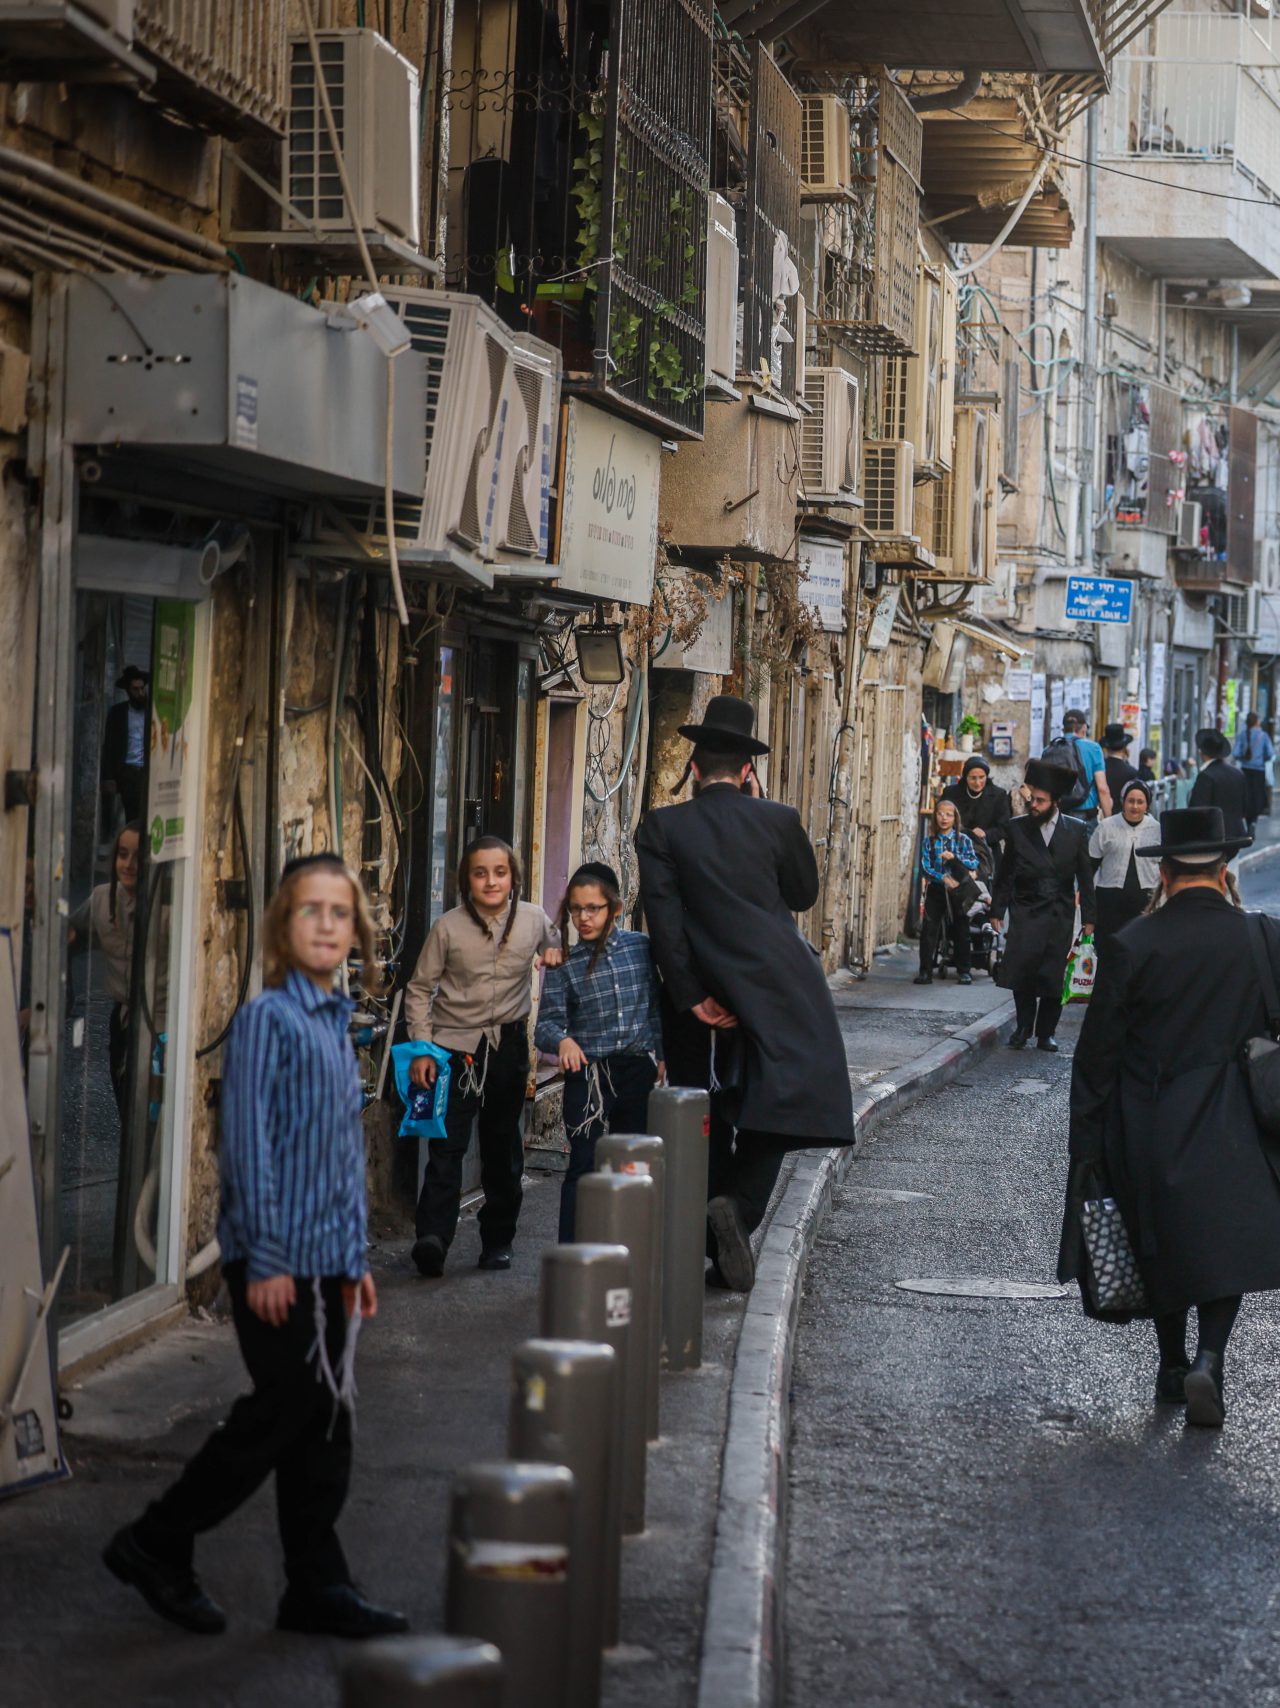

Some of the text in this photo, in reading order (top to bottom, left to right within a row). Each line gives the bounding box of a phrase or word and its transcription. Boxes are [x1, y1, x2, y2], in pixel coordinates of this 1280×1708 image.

[1071, 580, 1094, 591] אדם
[1098, 583, 1115, 593] חיי
[1100, 610, 1121, 620] ADAM
